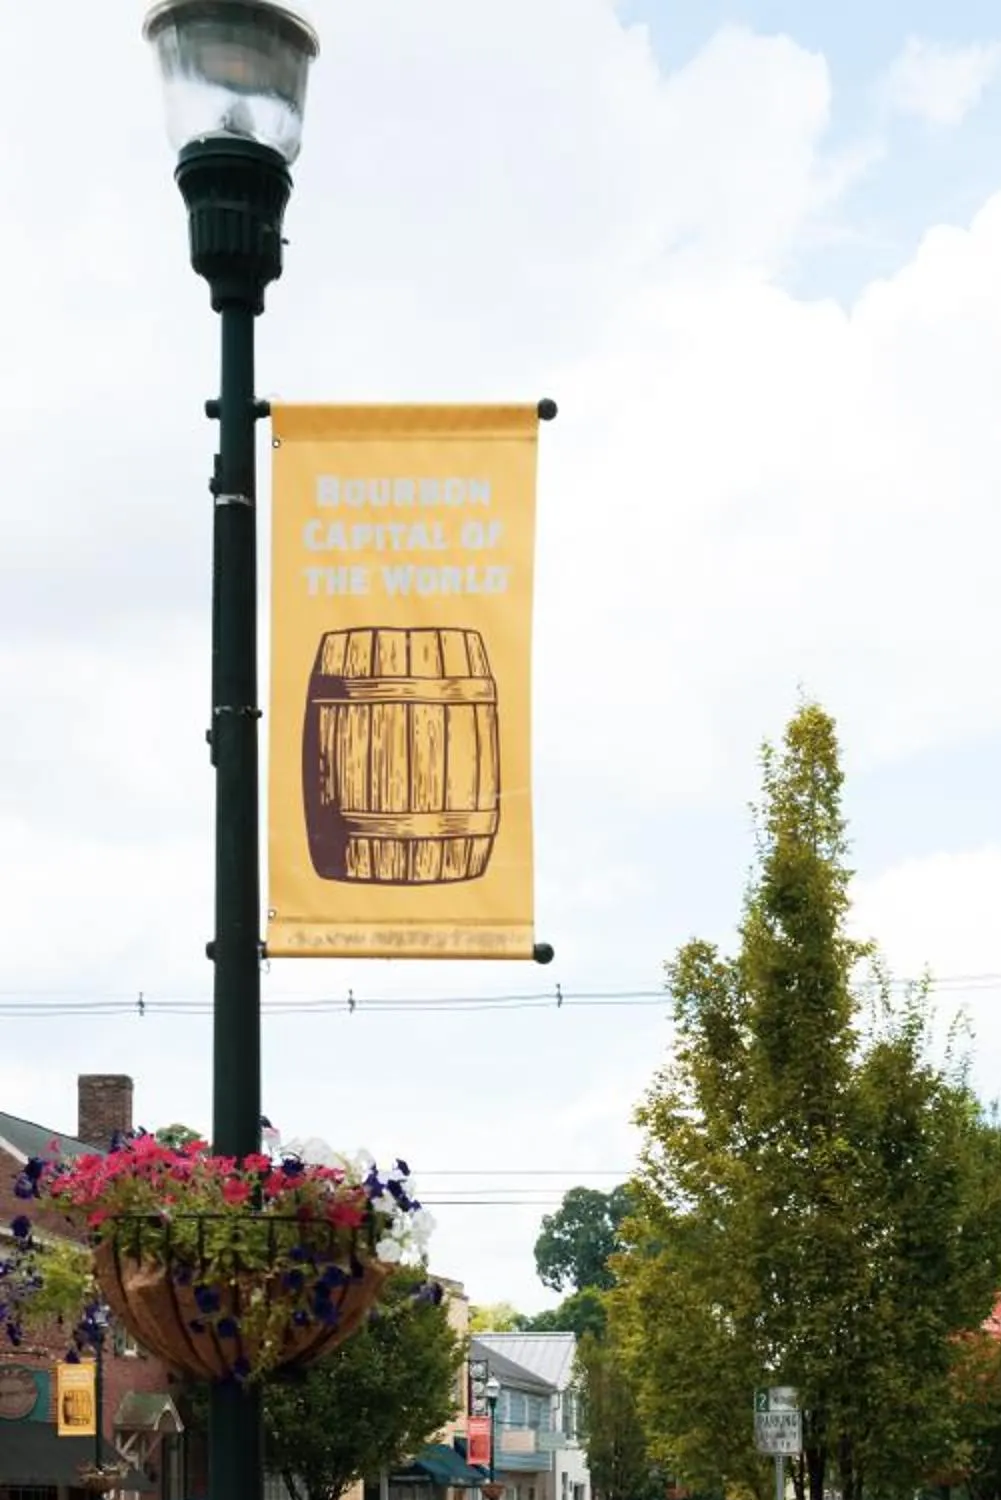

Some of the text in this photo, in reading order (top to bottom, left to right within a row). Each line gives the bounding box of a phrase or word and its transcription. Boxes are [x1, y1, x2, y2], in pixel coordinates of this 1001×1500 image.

[317, 476, 491, 507] BOURBON
[303, 518, 503, 550] CAPITAL OF
[304, 564, 509, 597] THE WORLD
[759, 1393, 767, 1410] 2
[757, 1415, 798, 1429] PARKING
